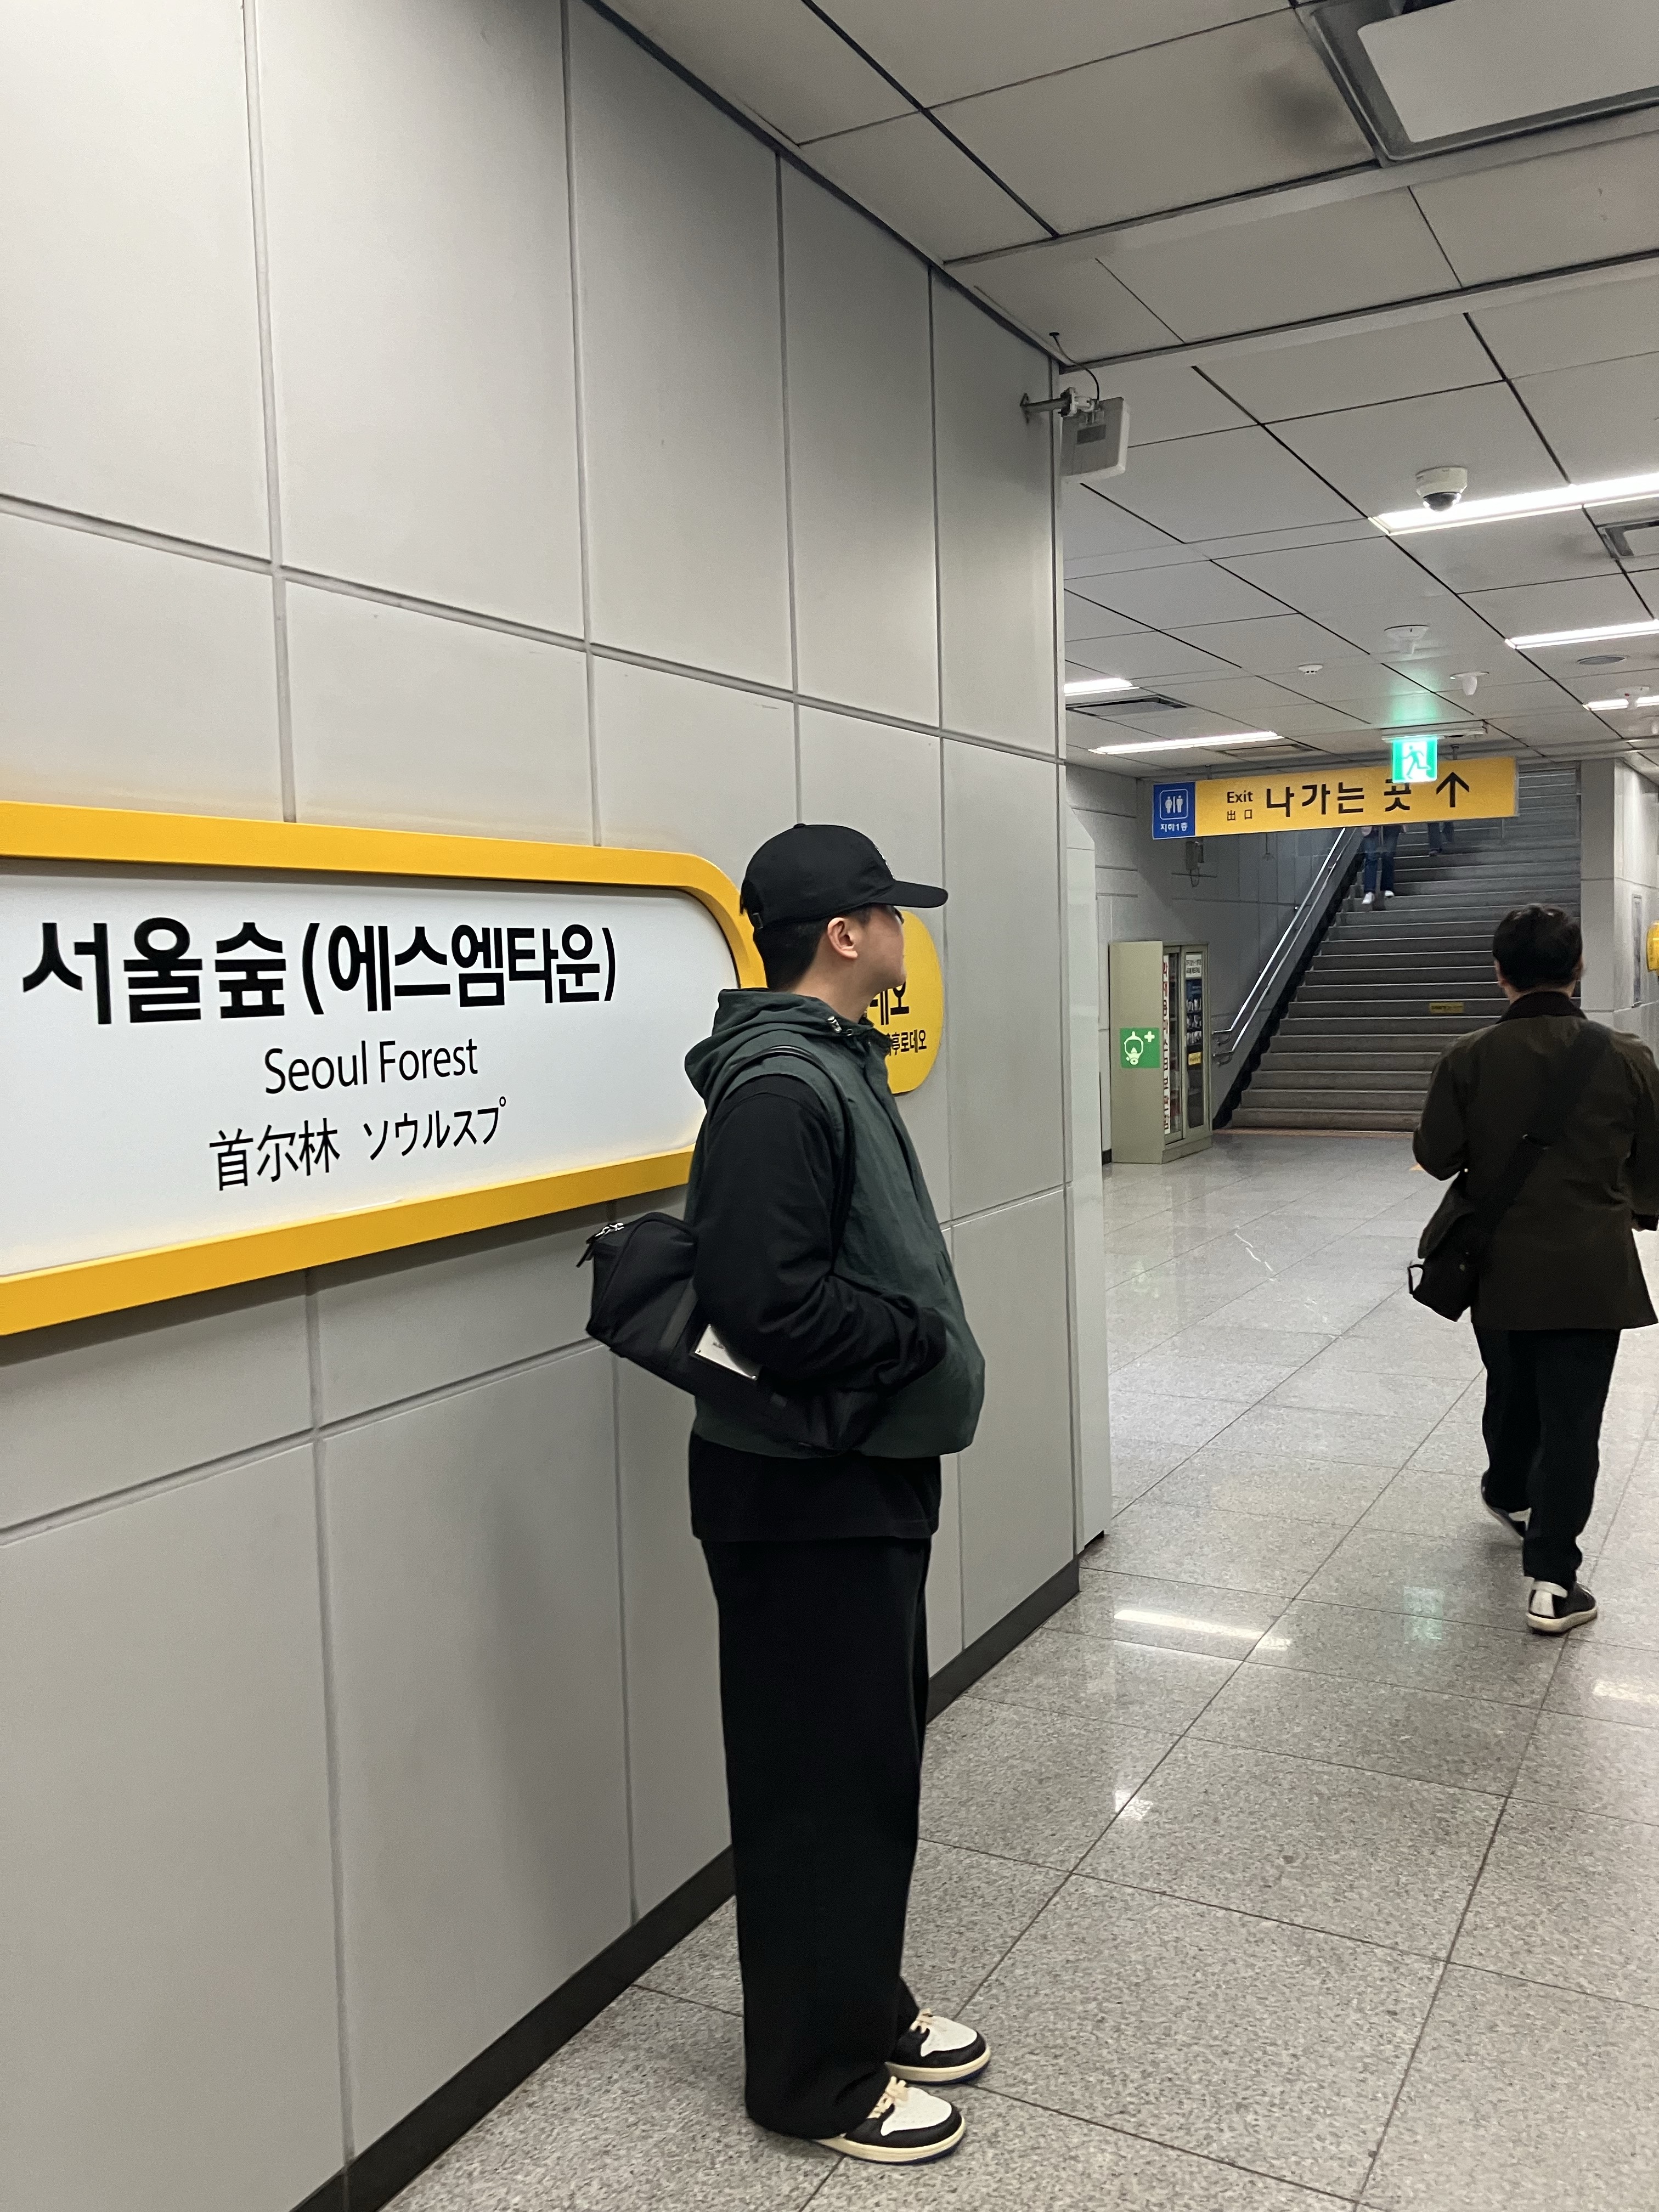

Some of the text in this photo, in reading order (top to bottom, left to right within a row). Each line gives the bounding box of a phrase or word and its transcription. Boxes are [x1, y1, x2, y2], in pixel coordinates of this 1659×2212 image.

[1227, 791, 1253, 804] Exit
[1266, 782, 1365, 817] 나가는
[22, 917, 616, 1025] 서울숲(에스엠타운)
[264, 1039, 478, 1094] Seoul Forest
[209, 1118, 340, 1191] 首尔林
[363, 1096, 506, 1160] ソウルスプ
